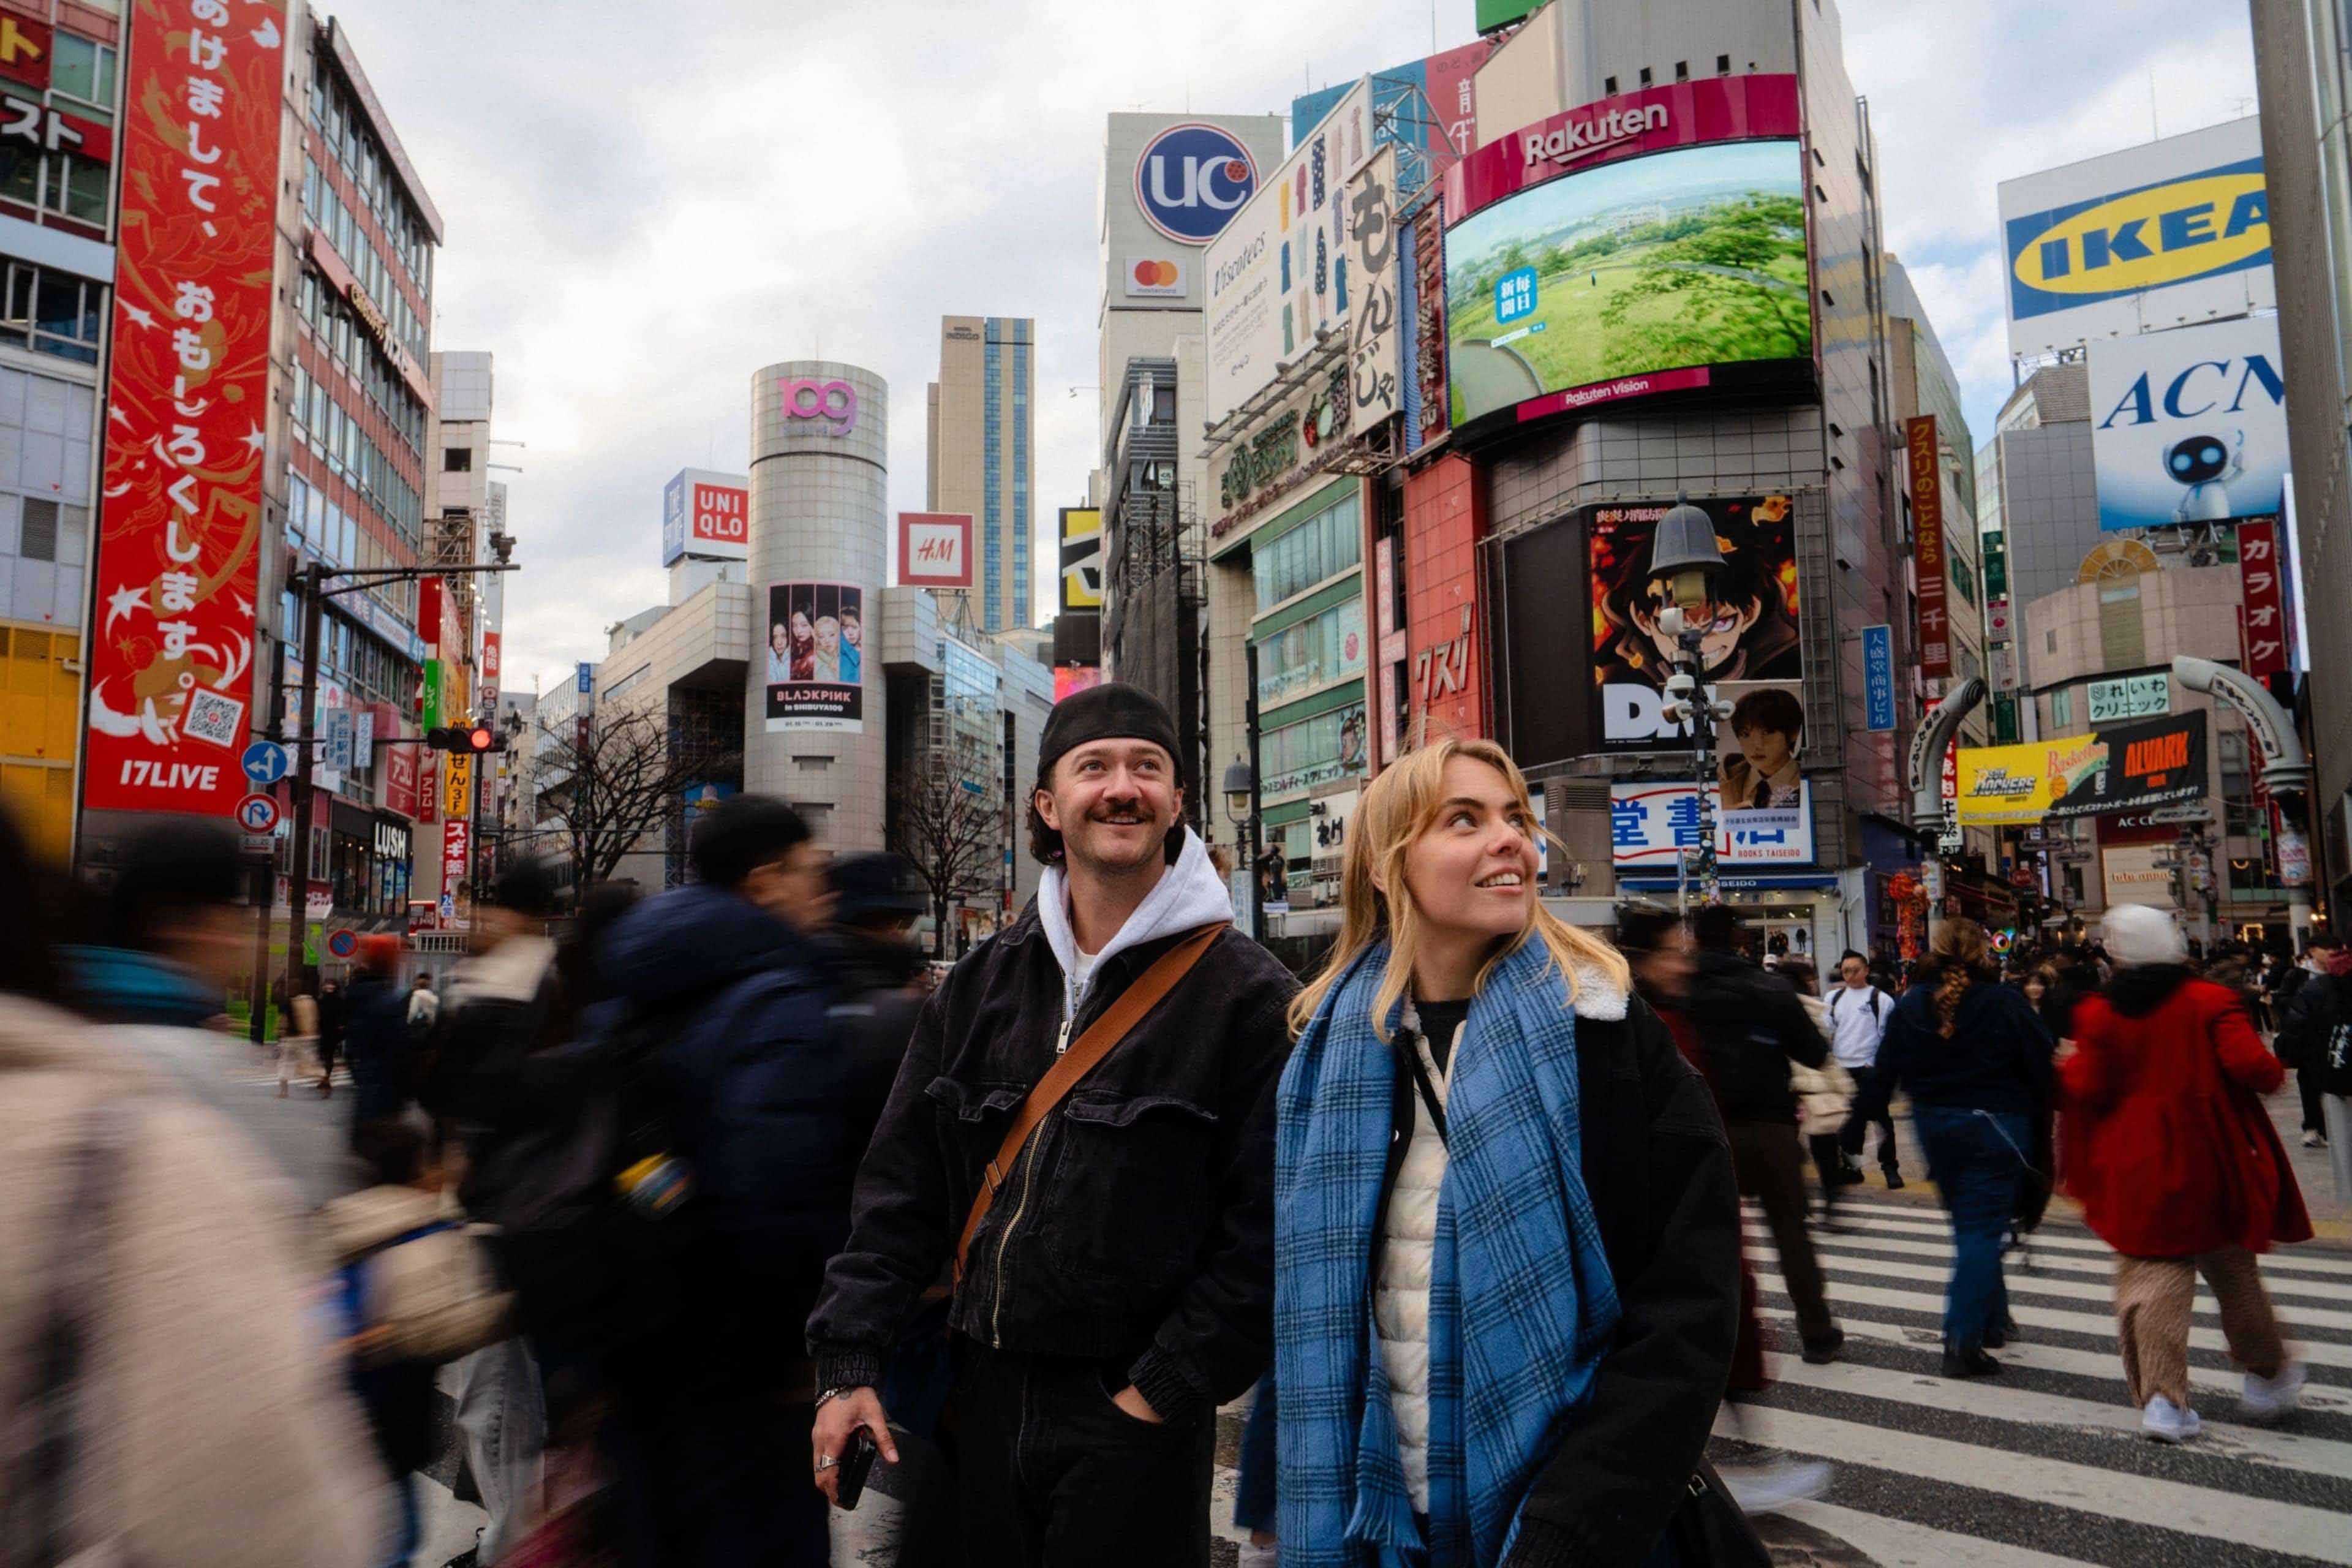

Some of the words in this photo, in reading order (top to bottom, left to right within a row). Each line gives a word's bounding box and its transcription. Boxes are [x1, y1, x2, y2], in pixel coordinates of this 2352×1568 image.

[1526, 102, 1668, 165] Rakuten
[1151, 153, 1247, 210] UC
[2040, 189, 2271, 281] IKEA
[1351, 169, 1395, 410] もんじゃ
[778, 378, 856, 437] 109
[1566, 387, 1611, 406] Rakuten
[1612, 380, 1648, 395] Vision
[157, 281, 213, 688] おもしろくします。
[700, 491, 739, 513] UNI
[1913, 424, 1937, 564] クスリのことなら
[699, 513, 743, 537] QLO
[1919, 576, 1948, 664] 三千里
[2243, 539, 2280, 661] カラオケ
[1869, 633, 1889, 726] 大盛堂商事ビル
[2111, 679, 2166, 698] れいわ
[2093, 698, 2166, 718] クリニック
[120, 759, 219, 791] 17LIVE
[393, 756, 412, 786] アコム
[2124, 731, 2190, 778] ALVARK
[421, 777, 432, 808] アコム
[452, 788, 464, 812] 3F
[375, 822, 405, 860] LUSH
[1766, 848, 1800, 858] TAISEIDO
